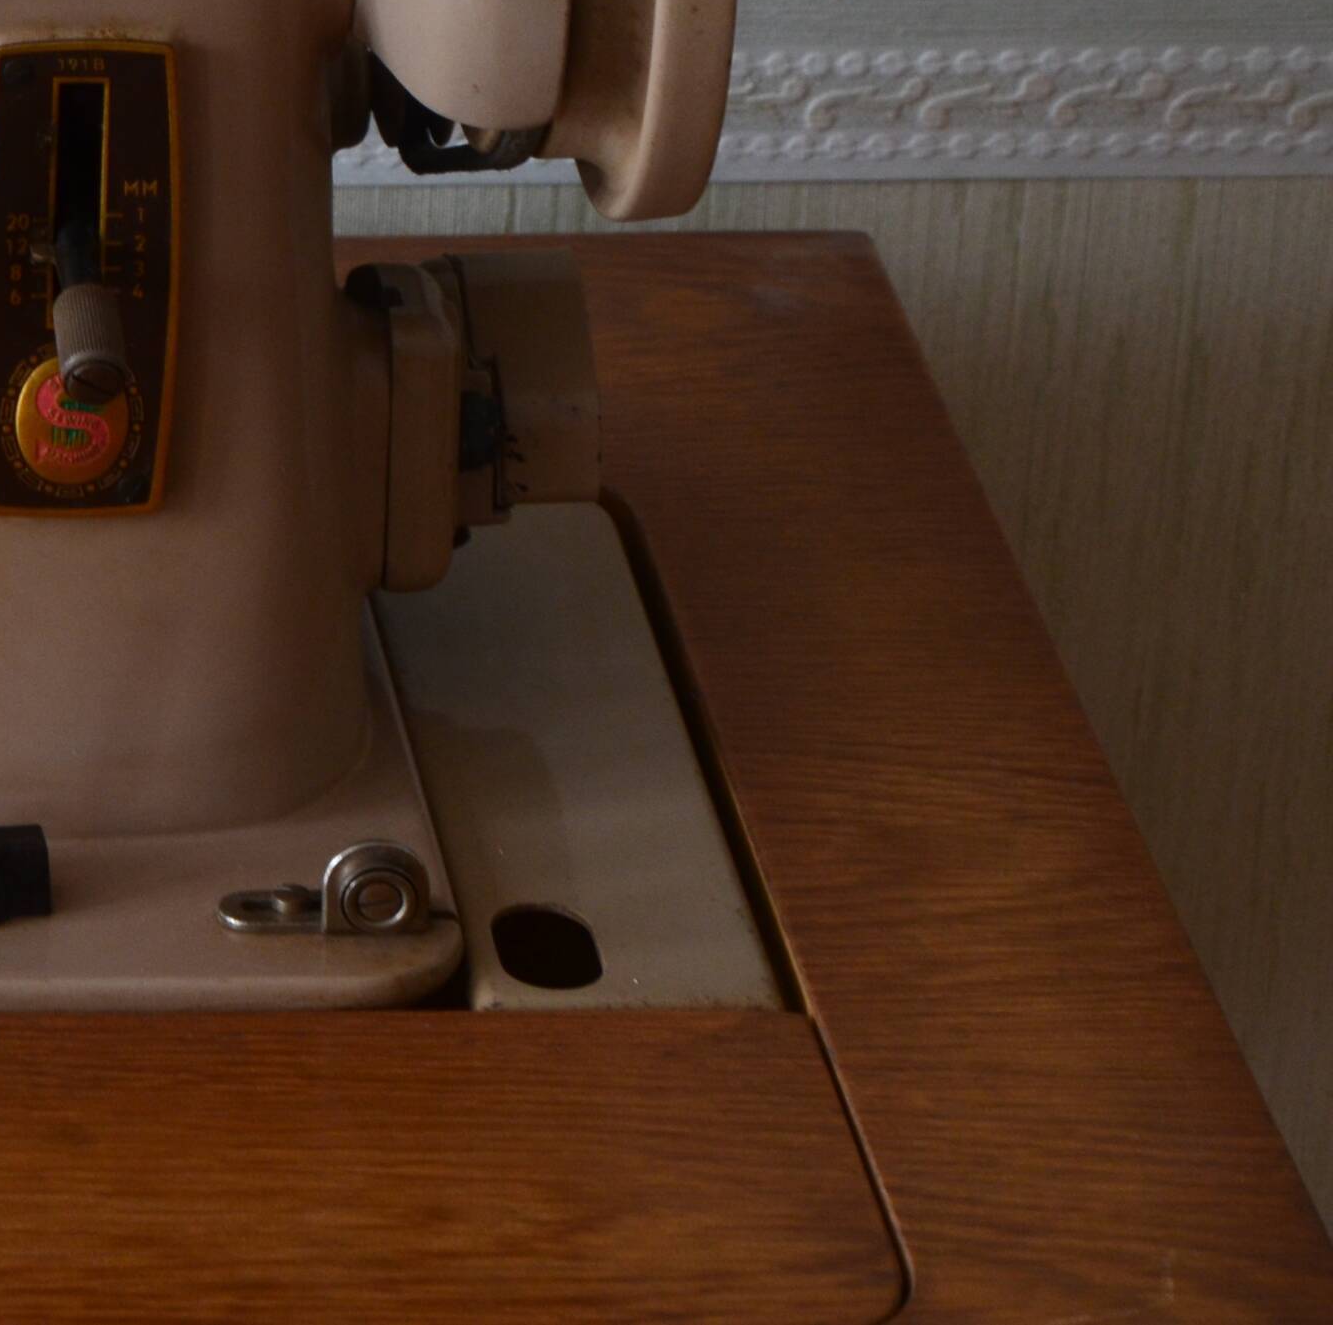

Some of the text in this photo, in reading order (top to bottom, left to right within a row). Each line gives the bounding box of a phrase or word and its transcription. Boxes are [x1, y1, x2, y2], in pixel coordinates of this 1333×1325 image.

[123, 179, 159, 197] MM
[6, 213, 31, 232] 20
[5, 237, 30, 256] 12
[133, 234, 147, 253] 2
[9, 264, 23, 283] 8
[134, 259, 146, 278] 3
[9, 287, 23, 306] 6
[132, 283, 145, 300] 4
